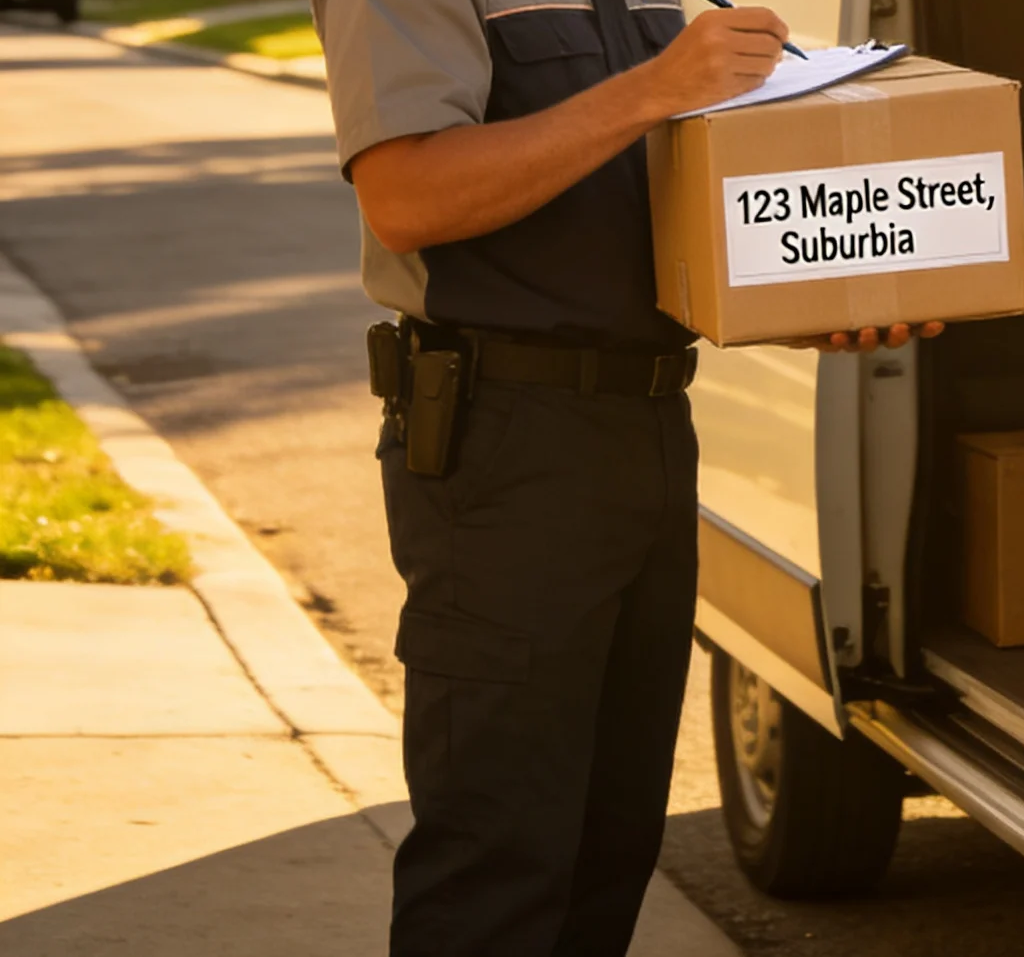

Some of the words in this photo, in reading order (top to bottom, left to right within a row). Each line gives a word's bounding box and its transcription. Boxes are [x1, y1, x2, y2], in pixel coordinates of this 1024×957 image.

[737, 187, 791, 225] 123
[799, 178, 889, 224] Maple
[898, 172, 995, 211] Street,
[781, 222, 915, 264] Suburbia
